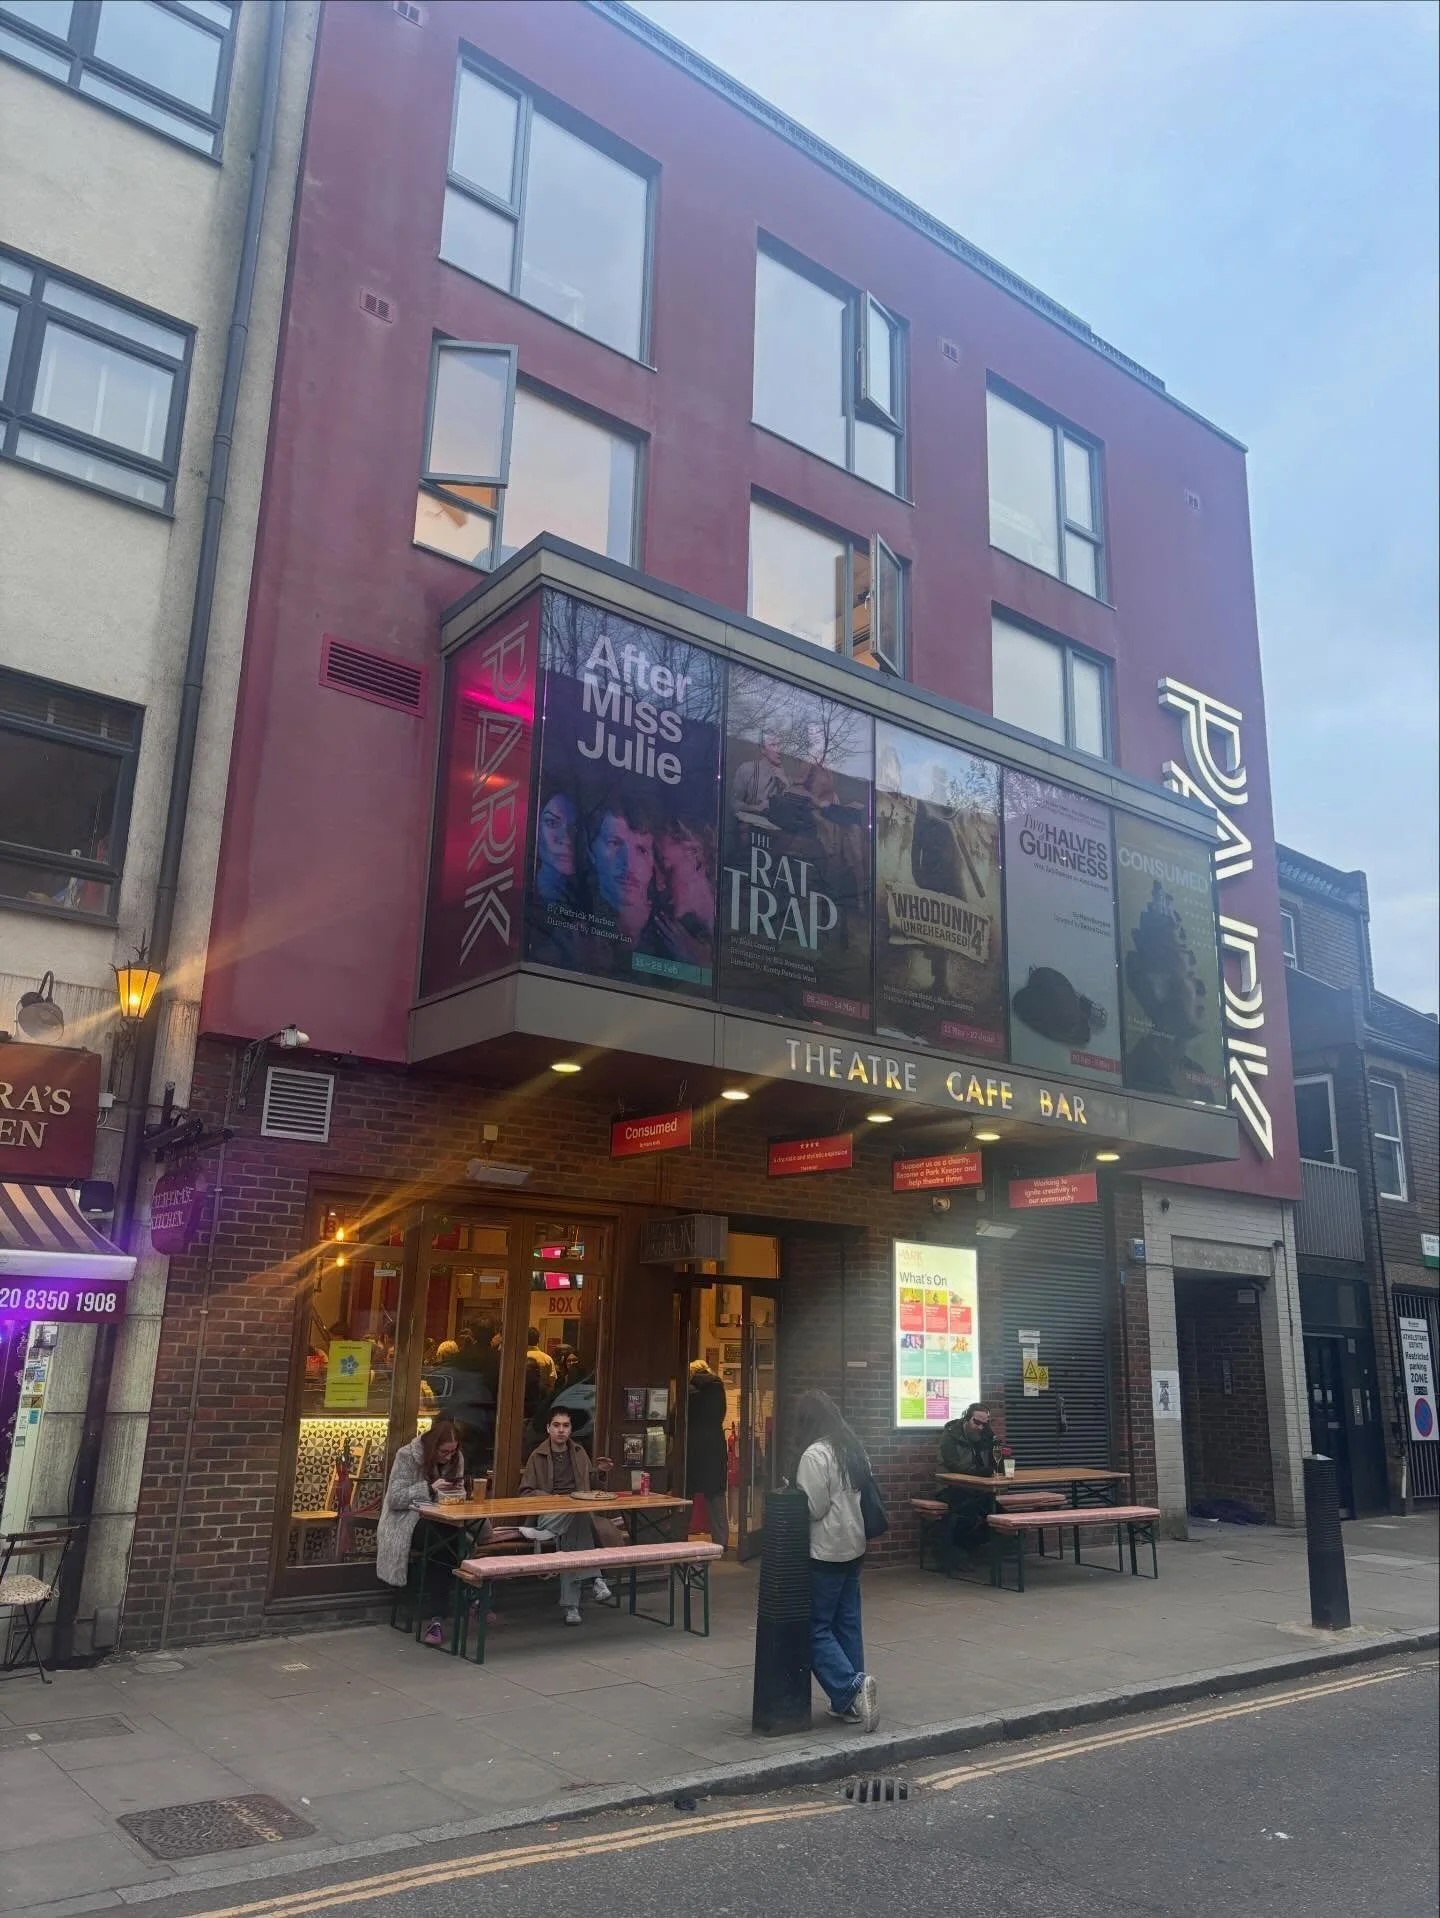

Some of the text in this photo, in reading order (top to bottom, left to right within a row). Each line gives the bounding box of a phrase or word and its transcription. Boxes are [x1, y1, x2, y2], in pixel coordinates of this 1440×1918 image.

[585, 634, 692, 703] After
[582, 672, 683, 743] Miss
[577, 720, 682, 785] Julie
[459, 620, 529, 967] PARK
[751, 832, 771, 849] THE
[1045, 824, 1107, 861] HALVES
[1020, 830, 1108, 880] GUINNESS
[751, 846, 815, 898] RAT
[1118, 847, 1209, 893] CONSUMED
[559, 906, 587, 920] Patrick
[723, 866, 838, 951] TRAP
[892, 892, 989, 941] WHODUNNIT
[547, 917, 580, 931] Directed
[580, 924, 590, 936] by
[971, 931, 983, 956] 4
[785, 1037, 1088, 1125] THEATRE CAFE BAR
[0, 1117, 48, 1148] EN
[625, 1117, 678, 1139] Consumed
[902, 1161, 925, 1171] Support
[941, 1167, 962, 1176] Keeper
[964, 1164, 977, 1172] and
[908, 1178, 922, 1188] help
[923, 1176, 945, 1184] theatre
[1024, 1189, 1041, 1198] ignite
[1042, 1186, 1070, 1195] creativity
[1034, 1178, 1060, 1187] Working
[1040, 1195, 1074, 1205] community
[900, 1271, 948, 1287] What's On
[0, 1288, 117, 1312] 20 8350 1908
[549, 1297, 573, 1313] BOX
[1405, 1351, 1429, 1360] Restricted
[1409, 1363, 1427, 1372] parking
[1411, 1373, 1429, 1384] ZONE
